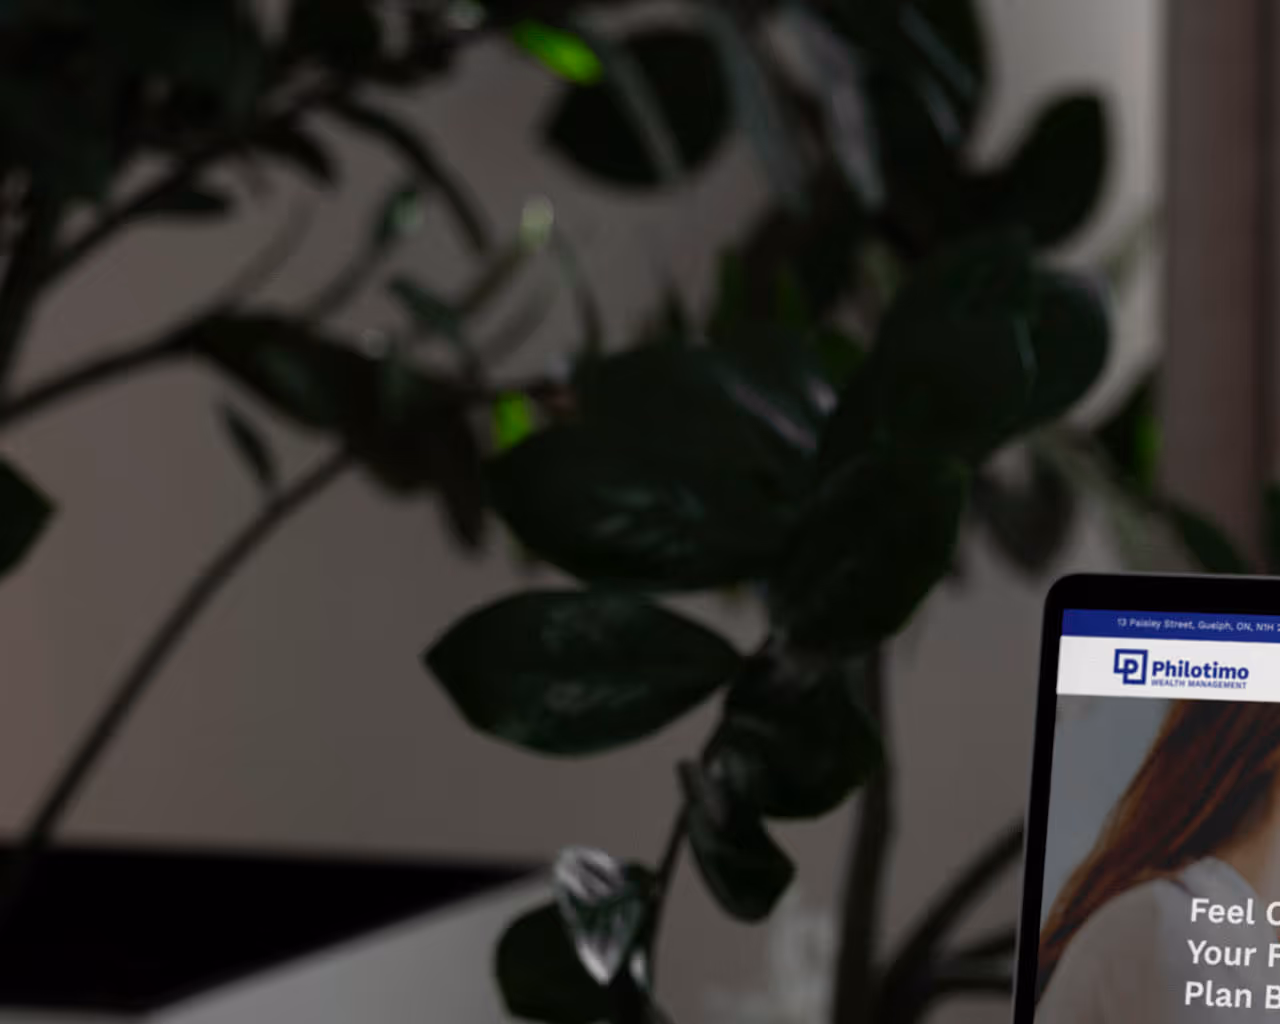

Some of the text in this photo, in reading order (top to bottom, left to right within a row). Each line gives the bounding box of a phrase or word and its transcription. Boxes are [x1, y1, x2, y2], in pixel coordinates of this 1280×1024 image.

[1117, 618, 1127, 627] 13
[1130, 619, 1161, 631] Paisley
[1164, 620, 1195, 631] Street,
[1198, 620, 1233, 632] Guelph,
[1236, 622, 1253, 632] ON,
[1152, 660, 1249, 680] Philotimo
[1188, 681, 1247, 690] MANAGEMENT
[1191, 898, 1256, 926] Feel
[1187, 939, 1257, 967] Your
[1184, 980, 1253, 1009] Plan
